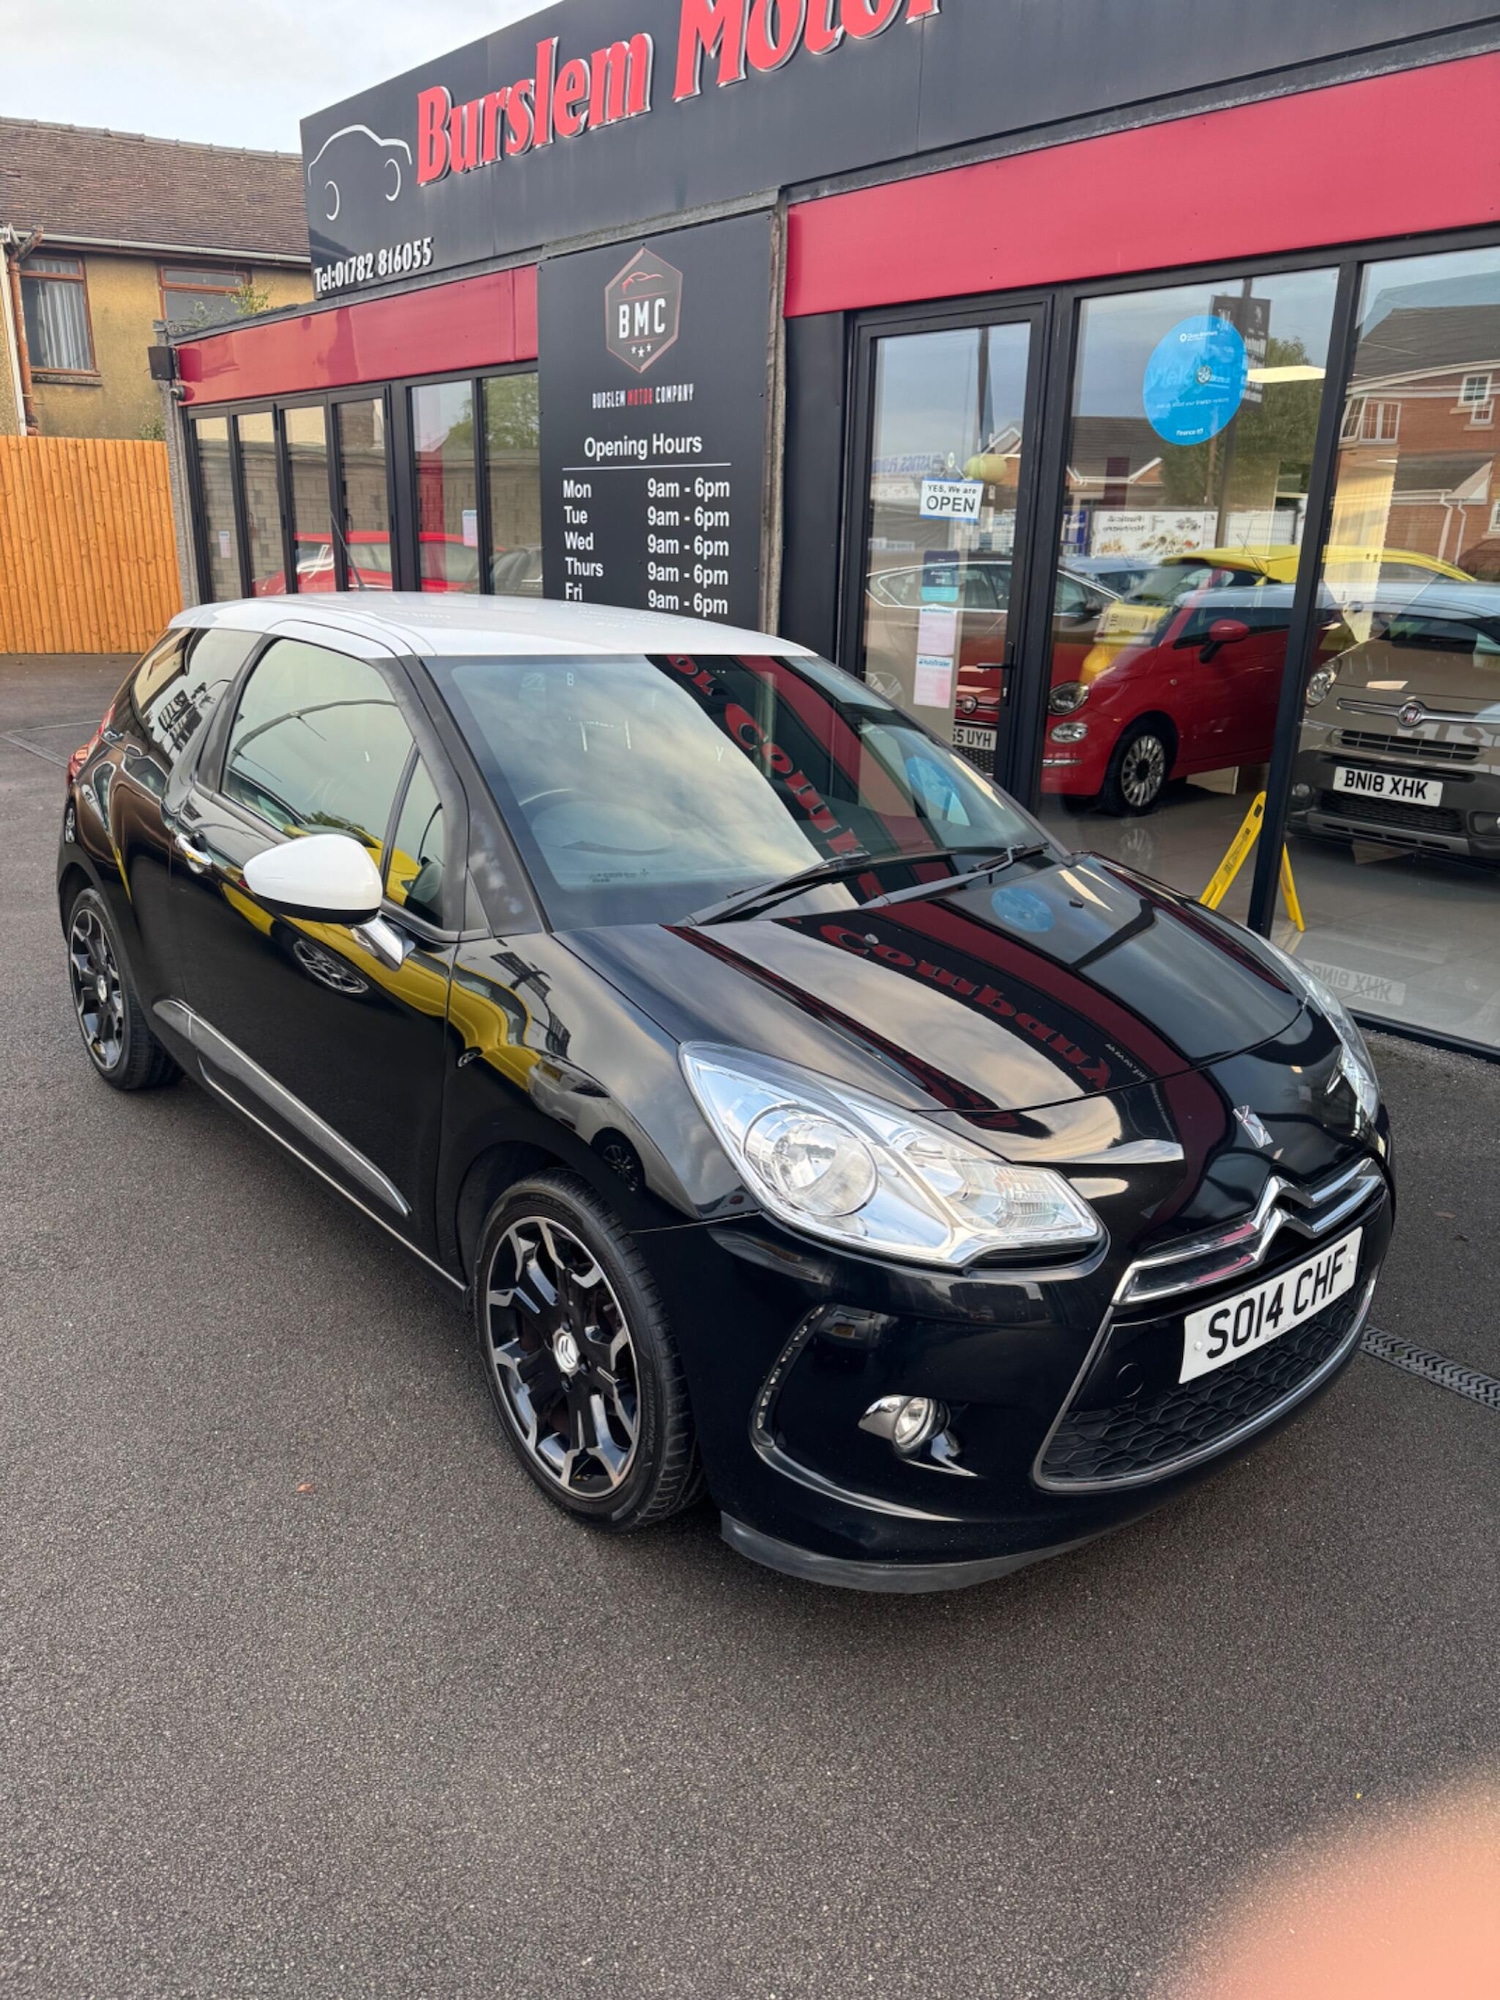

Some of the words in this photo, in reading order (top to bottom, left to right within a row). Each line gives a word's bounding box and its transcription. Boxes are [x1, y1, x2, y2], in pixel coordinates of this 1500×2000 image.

[416, 35, 655, 187] Burslem
[313, 252, 375, 293] Tel:01782
[378, 237, 434, 278] 816055
[618, 298, 667, 339] BMC
[592, 389, 626, 409] BURSLEM
[627, 387, 654, 406] MOTOR
[655, 383, 694, 404] COMPANY
[584, 436, 648, 461] Opening
[652, 433, 703, 456] Hours
[563, 479, 592, 499] Mon
[647, 478, 680, 499] 9am
[694, 477, 730, 503] 6pm
[927, 484, 947, 494] YES,
[949, 486, 960, 494] We
[963, 487, 977, 495] are
[564, 505, 588, 525] Tue
[926, 495, 975, 513] OPEN
[647, 506, 680, 527] 9am
[694, 505, 730, 531] 6pm
[564, 532, 594, 551] Wed
[647, 534, 679, 556] 9am
[694, 534, 729, 560] 6pm
[565, 557, 604, 578] Thurs
[647, 561, 679, 583] 9am
[693, 562, 729, 588] 6pm
[565, 582, 583, 602] Fri
[648, 589, 679, 611] 9am
[693, 591, 728, 615] 6pm
[967, 731, 992, 748] UYH
[1344, 770, 1385, 793] BN18
[1389, 776, 1429, 800] XHK
[1206, 1282, 1285, 1359] SO14
[1293, 1244, 1347, 1316] CHF
